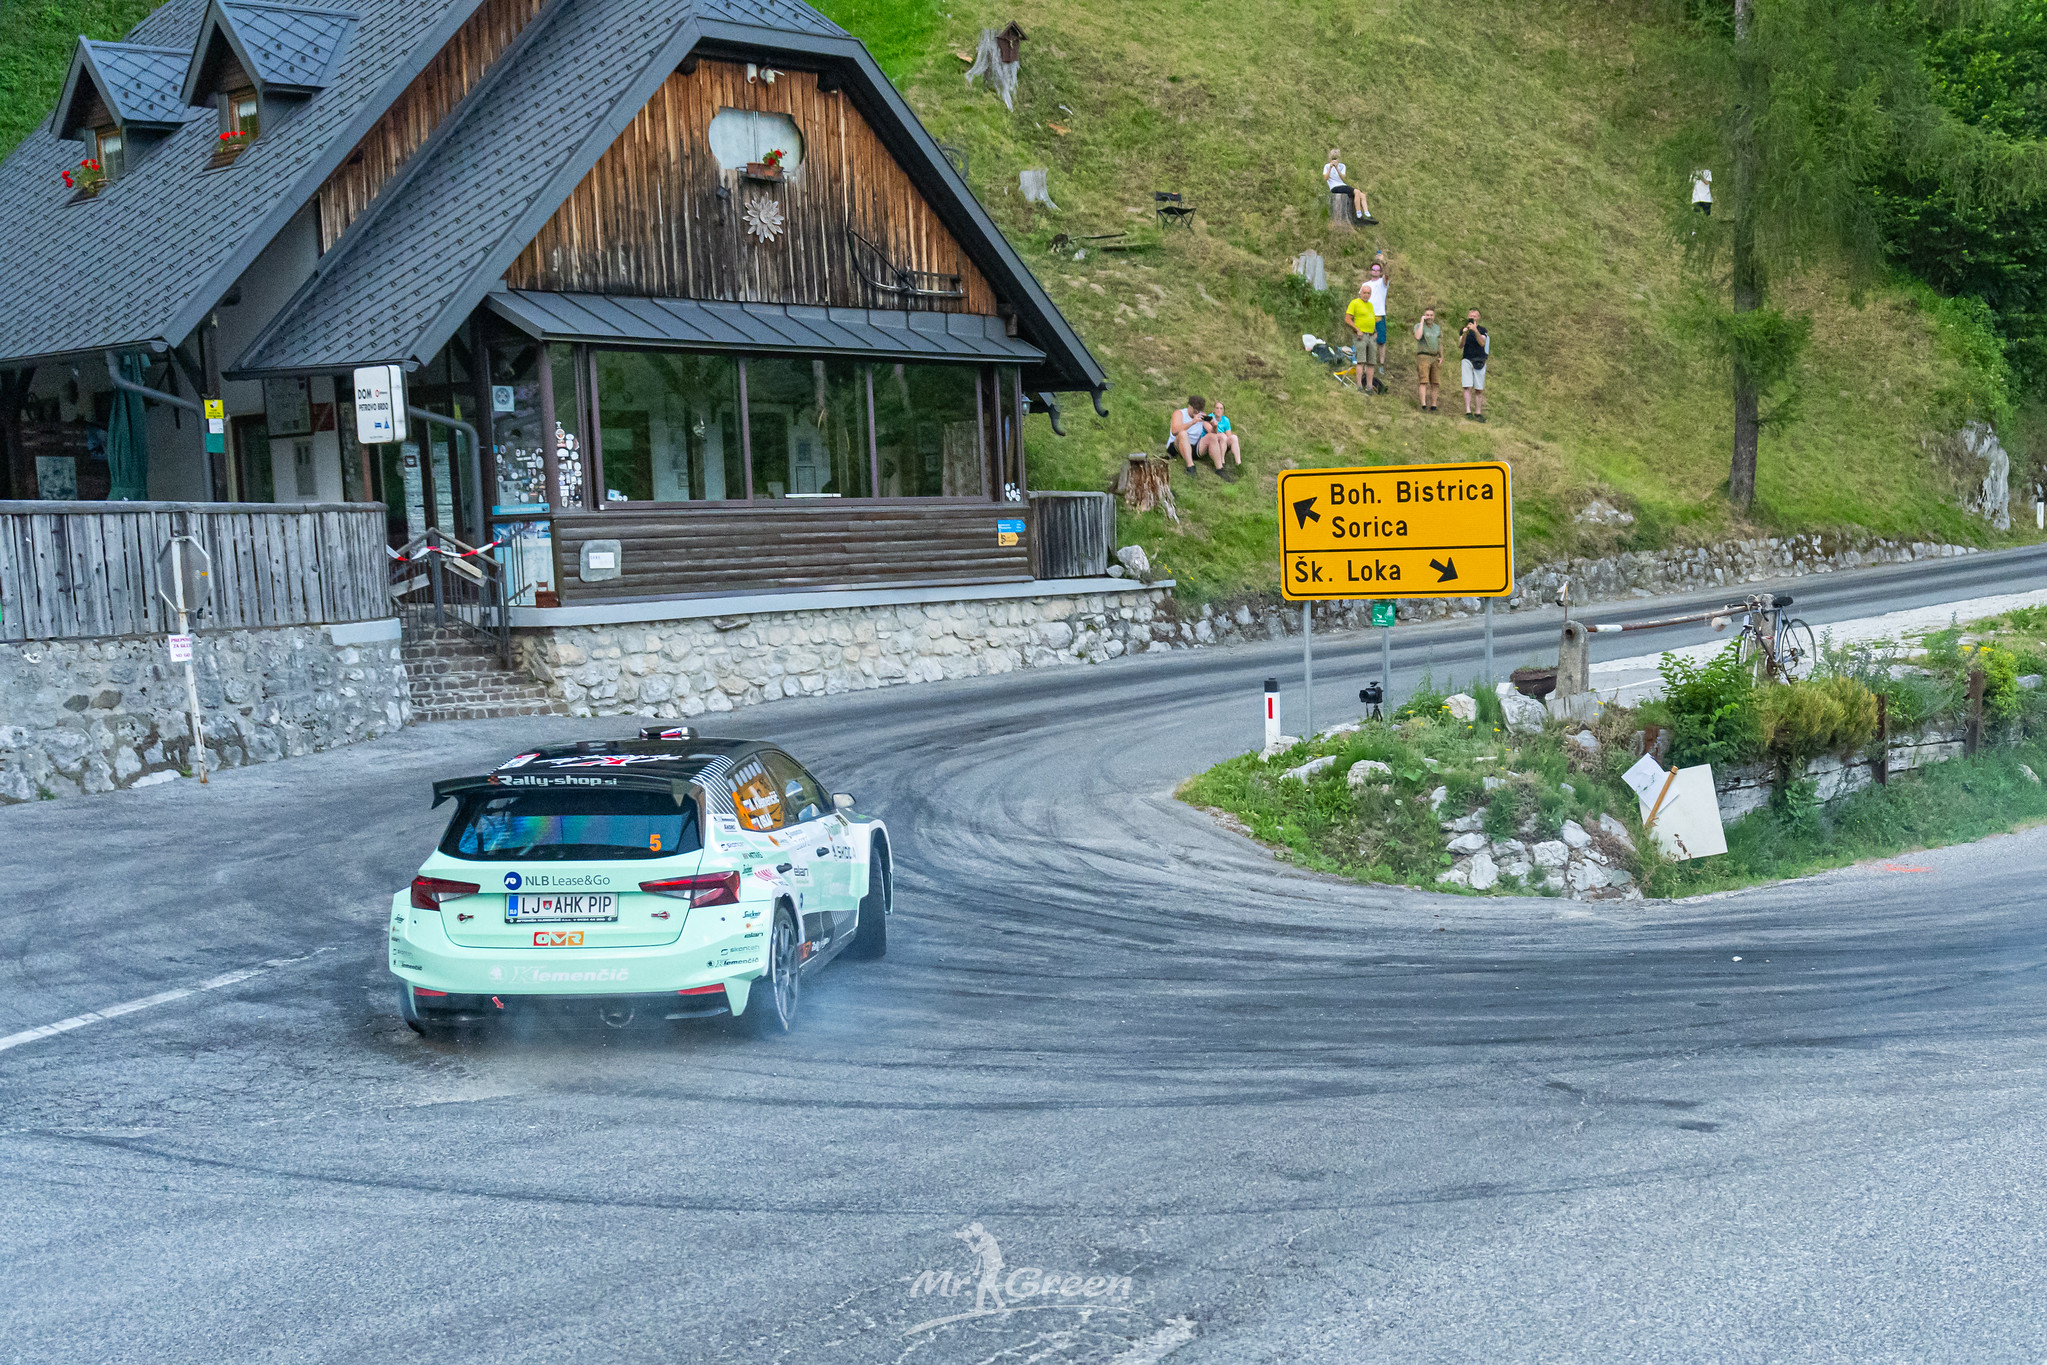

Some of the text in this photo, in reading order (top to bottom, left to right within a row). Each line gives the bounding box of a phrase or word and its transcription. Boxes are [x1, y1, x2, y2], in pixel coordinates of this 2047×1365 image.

[358, 388, 372, 400] DOM
[359, 403, 376, 411] PETROVO
[1330, 479, 1494, 506] Boh. Bistrica
[1331, 516, 1408, 538] Sorica
[1294, 555, 1401, 583] Šk. Loka
[649, 834, 662, 852] 5
[525, 874, 611, 886] NLB Lease&Go
[521, 895, 612, 914] LJ AHK PIP
[509, 965, 629, 985] Klemenčič
